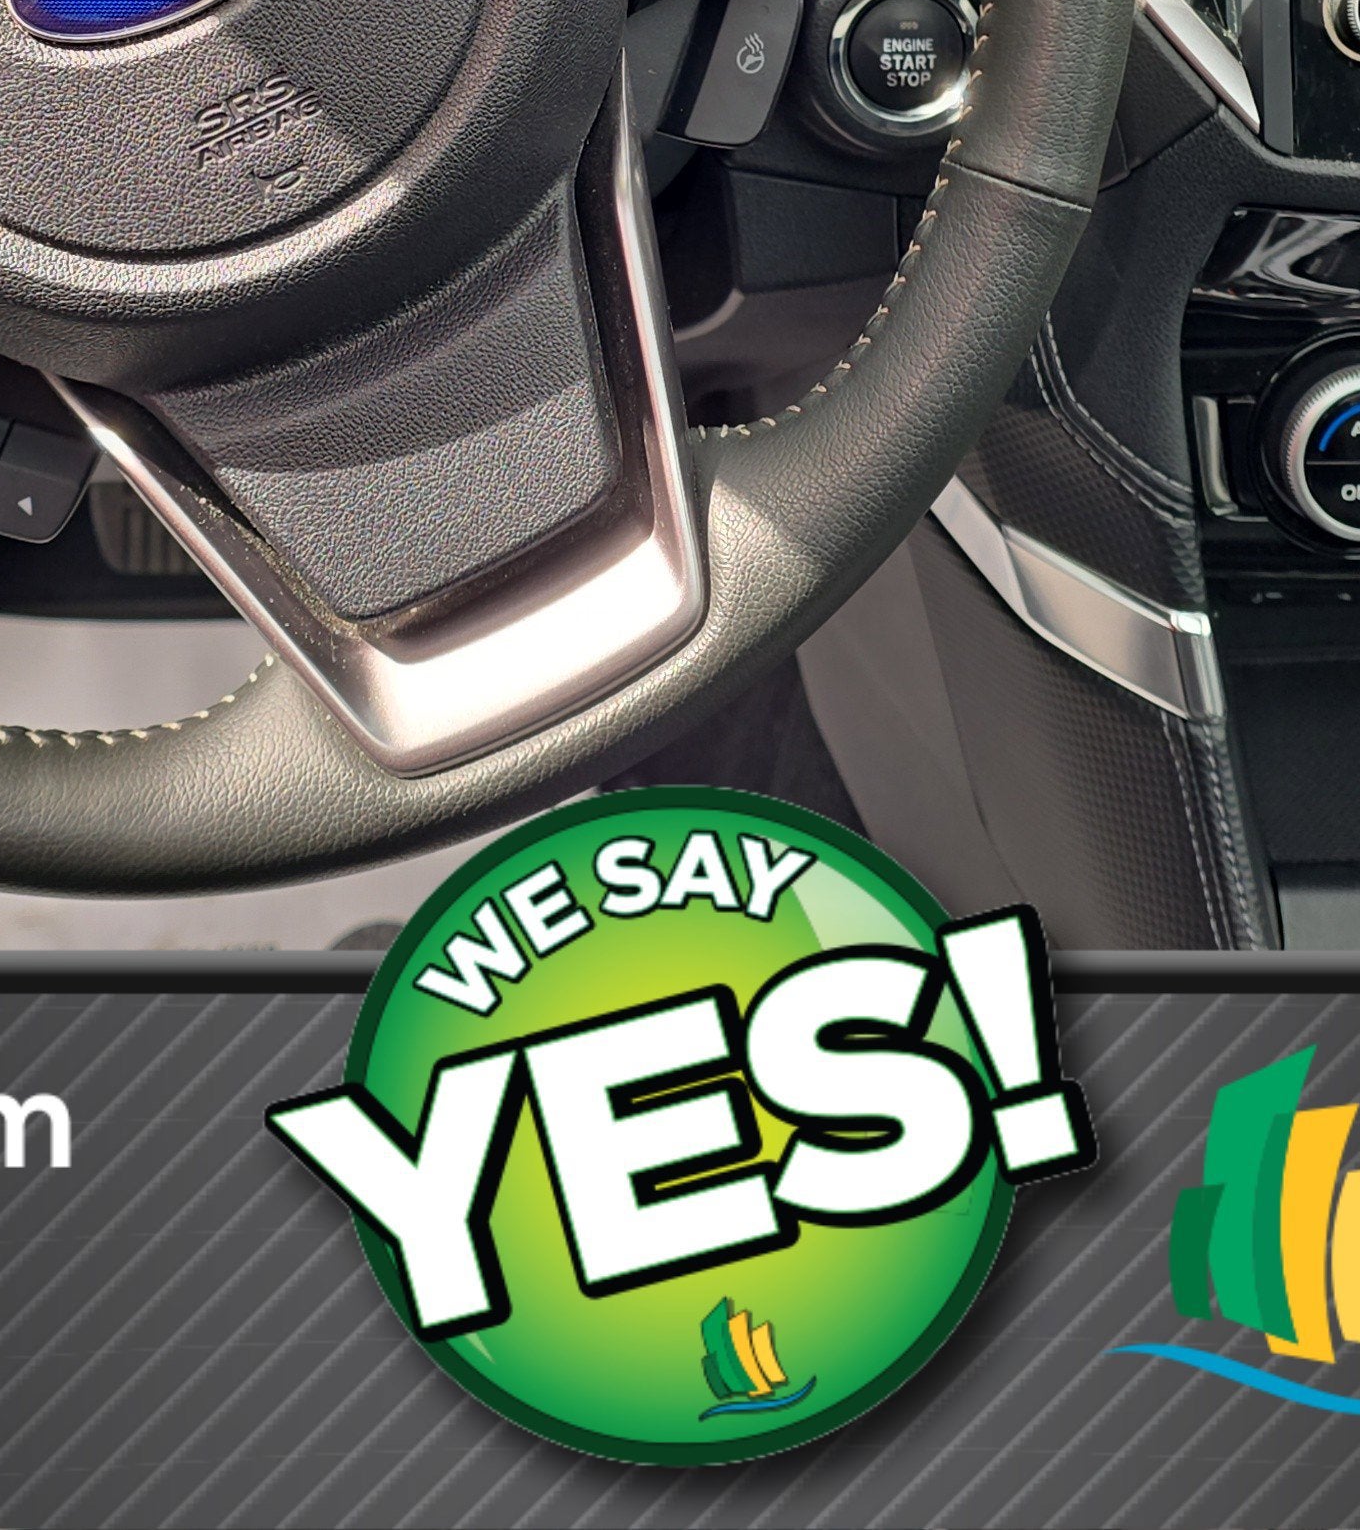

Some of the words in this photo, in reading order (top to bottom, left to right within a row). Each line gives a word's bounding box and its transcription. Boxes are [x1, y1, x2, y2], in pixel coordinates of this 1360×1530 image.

[883, 37, 935, 53] ENGINE
[880, 53, 938, 71] START
[886, 71, 932, 87] STOP
